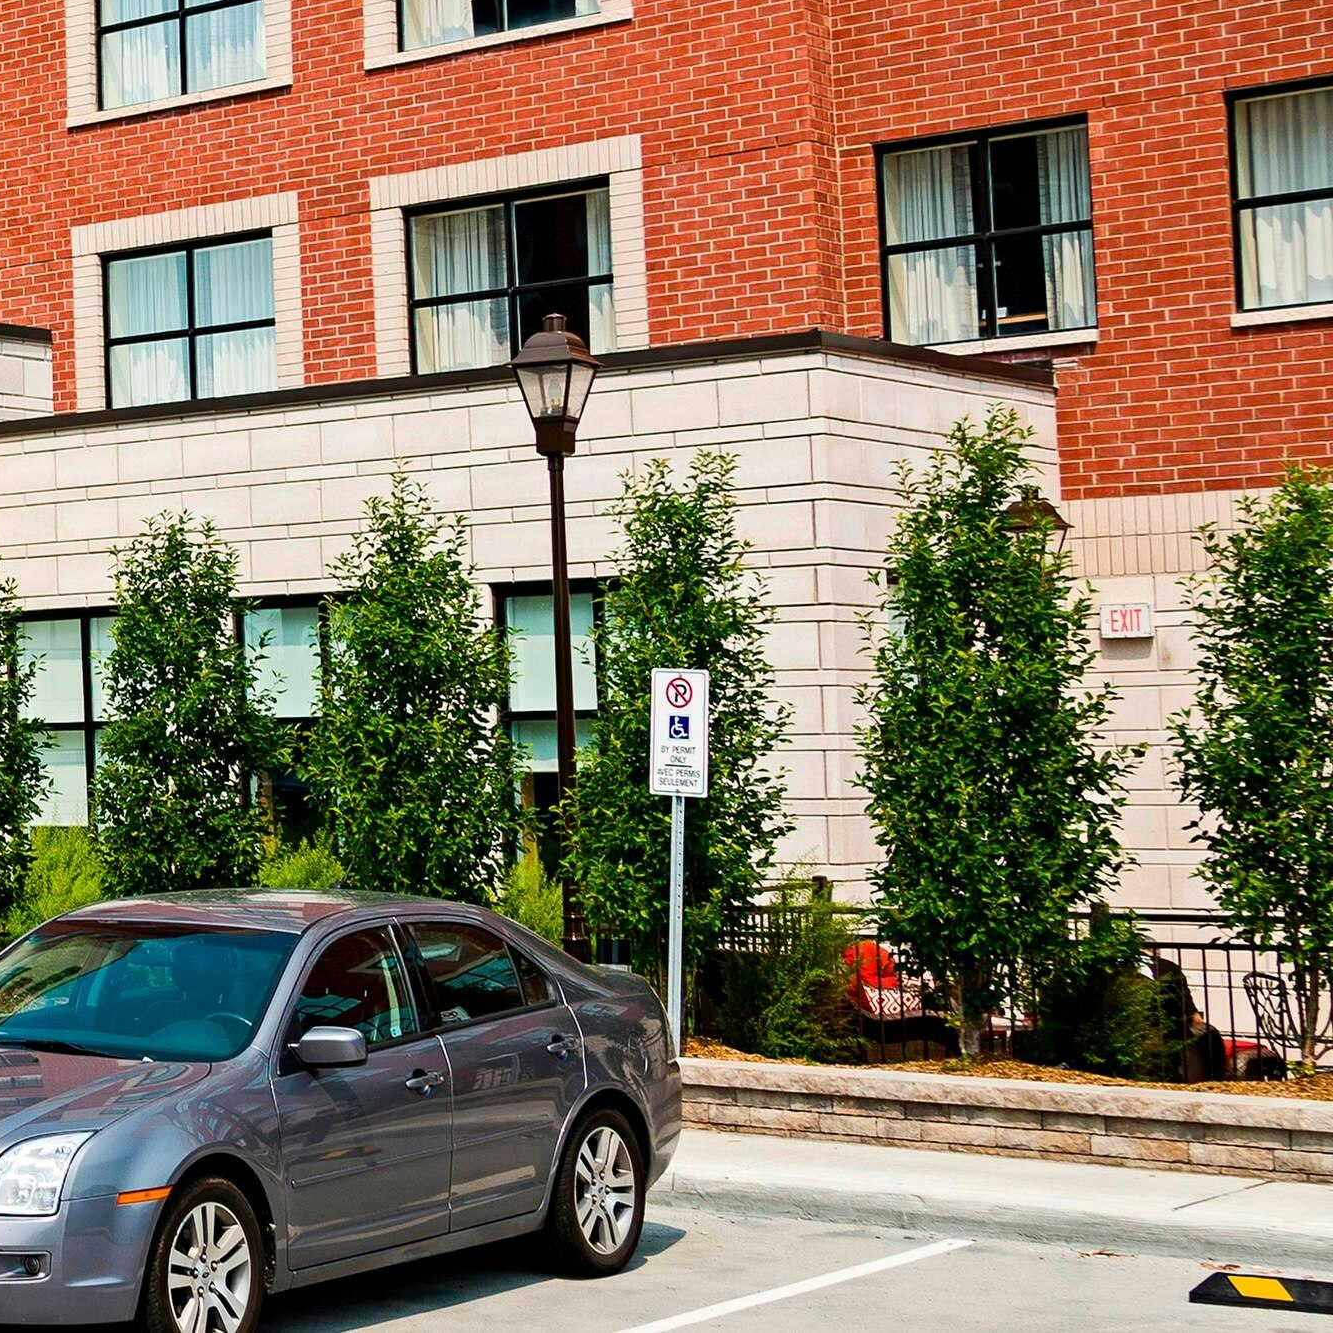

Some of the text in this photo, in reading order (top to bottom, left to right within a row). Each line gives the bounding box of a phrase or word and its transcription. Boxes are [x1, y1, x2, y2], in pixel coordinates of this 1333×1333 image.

[1110, 608, 1142, 633] EXIT
[660, 745, 696, 754] BY PERMIT
[670, 755, 687, 764] ONLY
[657, 768, 701, 778] AVEC PERMIS
[658, 777, 699, 787] SEULEMENT
